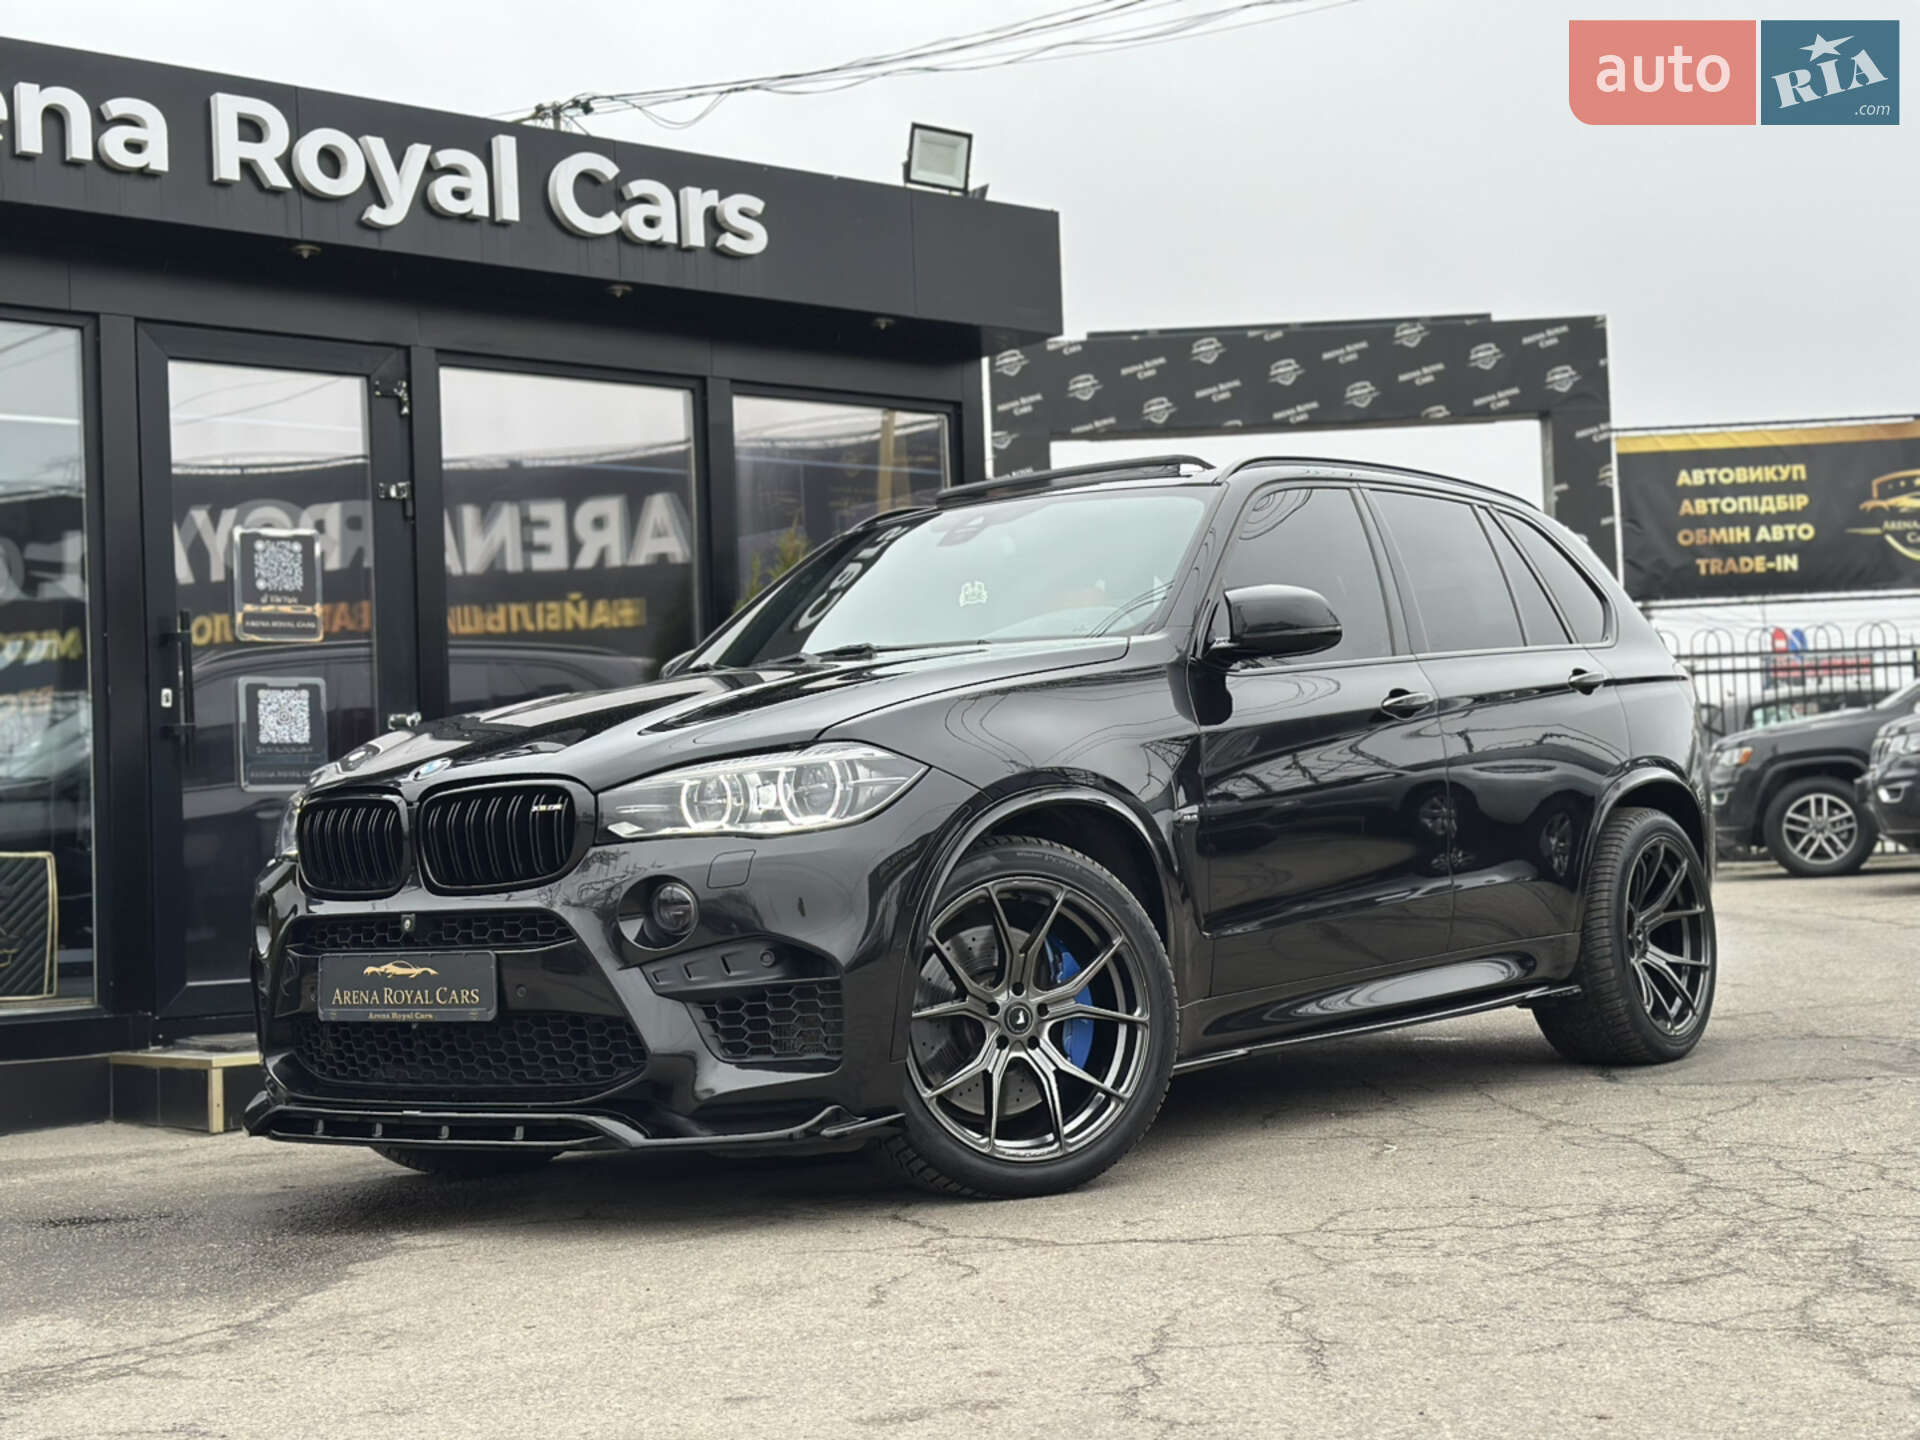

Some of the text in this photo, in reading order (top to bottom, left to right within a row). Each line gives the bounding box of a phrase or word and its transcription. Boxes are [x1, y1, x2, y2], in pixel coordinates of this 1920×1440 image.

[0, 80, 769, 257] na Royal Cars
[1676, 464, 1808, 487] АВТОВИКУП
[1679, 494, 1810, 517] АВТОПІДБІР
[1677, 523, 1816, 547] ОБМІН АВТО
[1696, 554, 1799, 577] TRADE-IN
[332, 986, 480, 1005] ARENA ROYAL CARS
